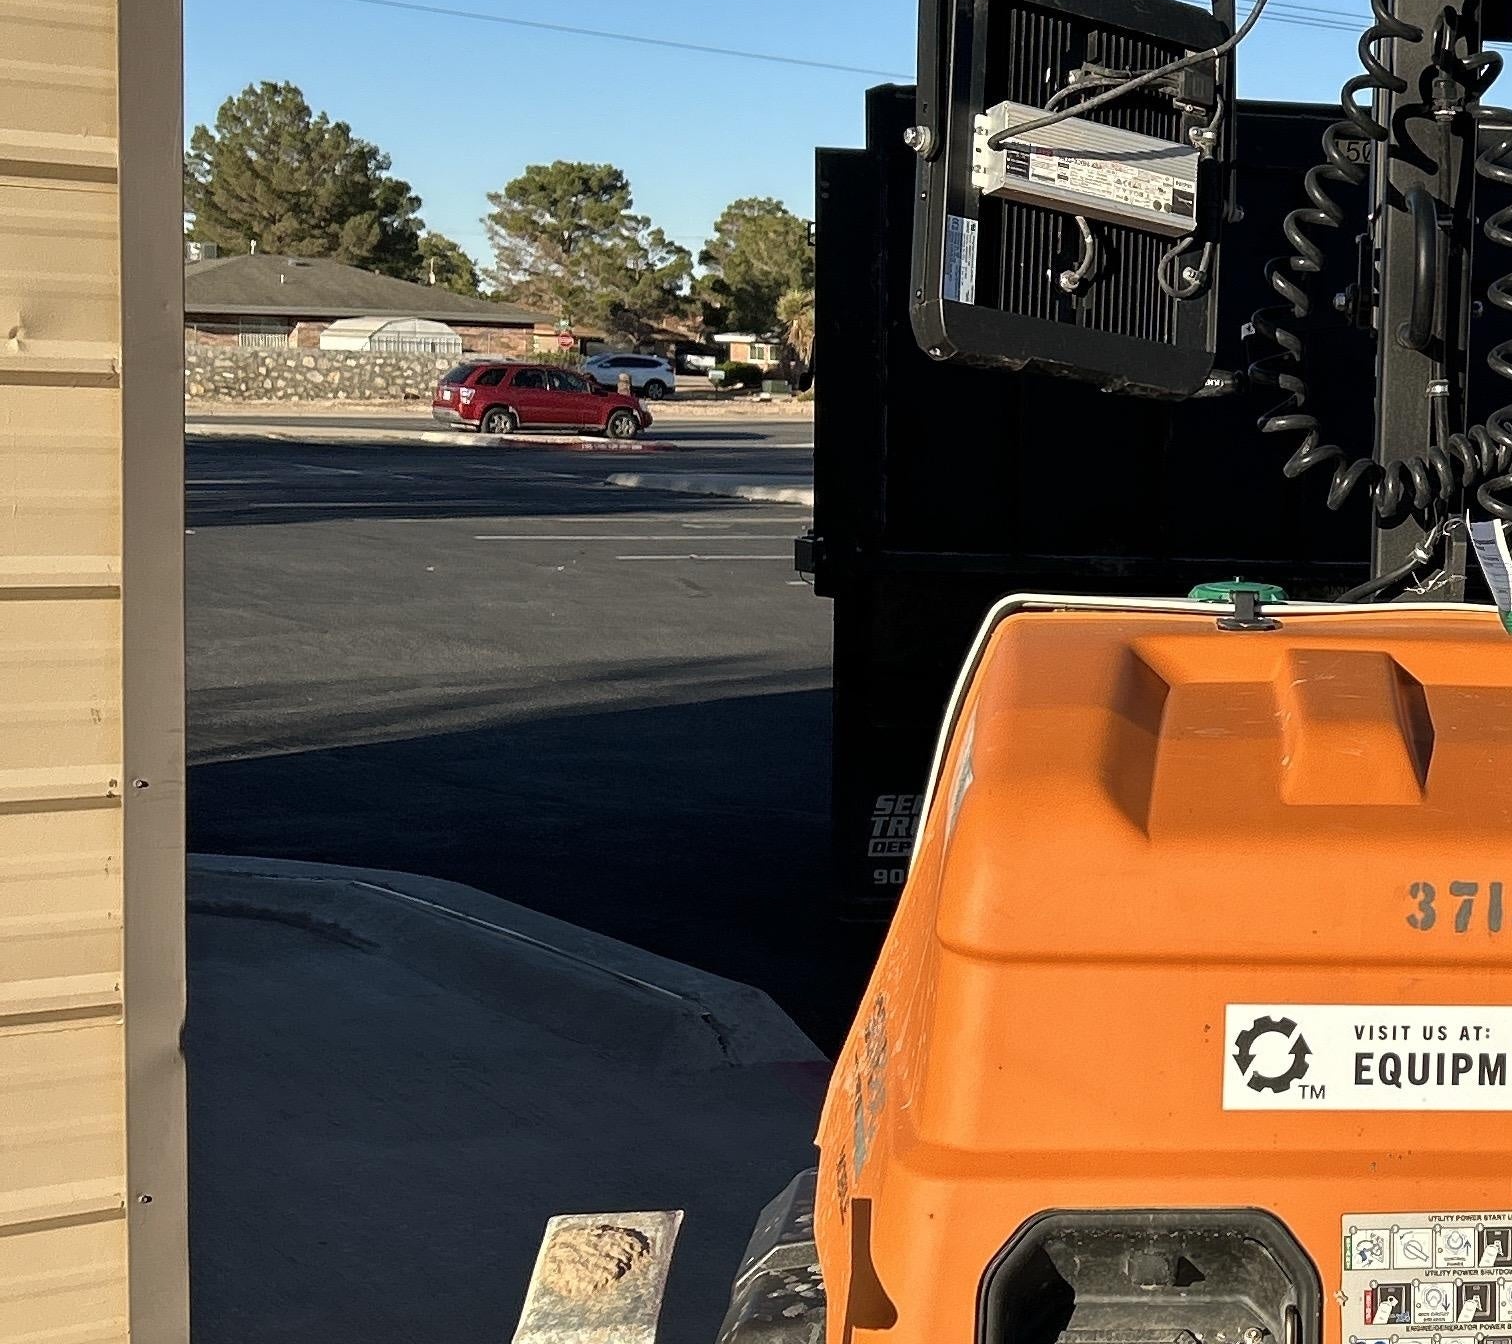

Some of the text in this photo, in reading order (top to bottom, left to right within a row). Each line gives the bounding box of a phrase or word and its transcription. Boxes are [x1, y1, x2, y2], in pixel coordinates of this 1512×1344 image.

[1354, 1025, 1491, 1041] VISIT US AT:
[1298, 1084, 1327, 1100] TM
[1455, 1214, 1482, 1222] POWER
